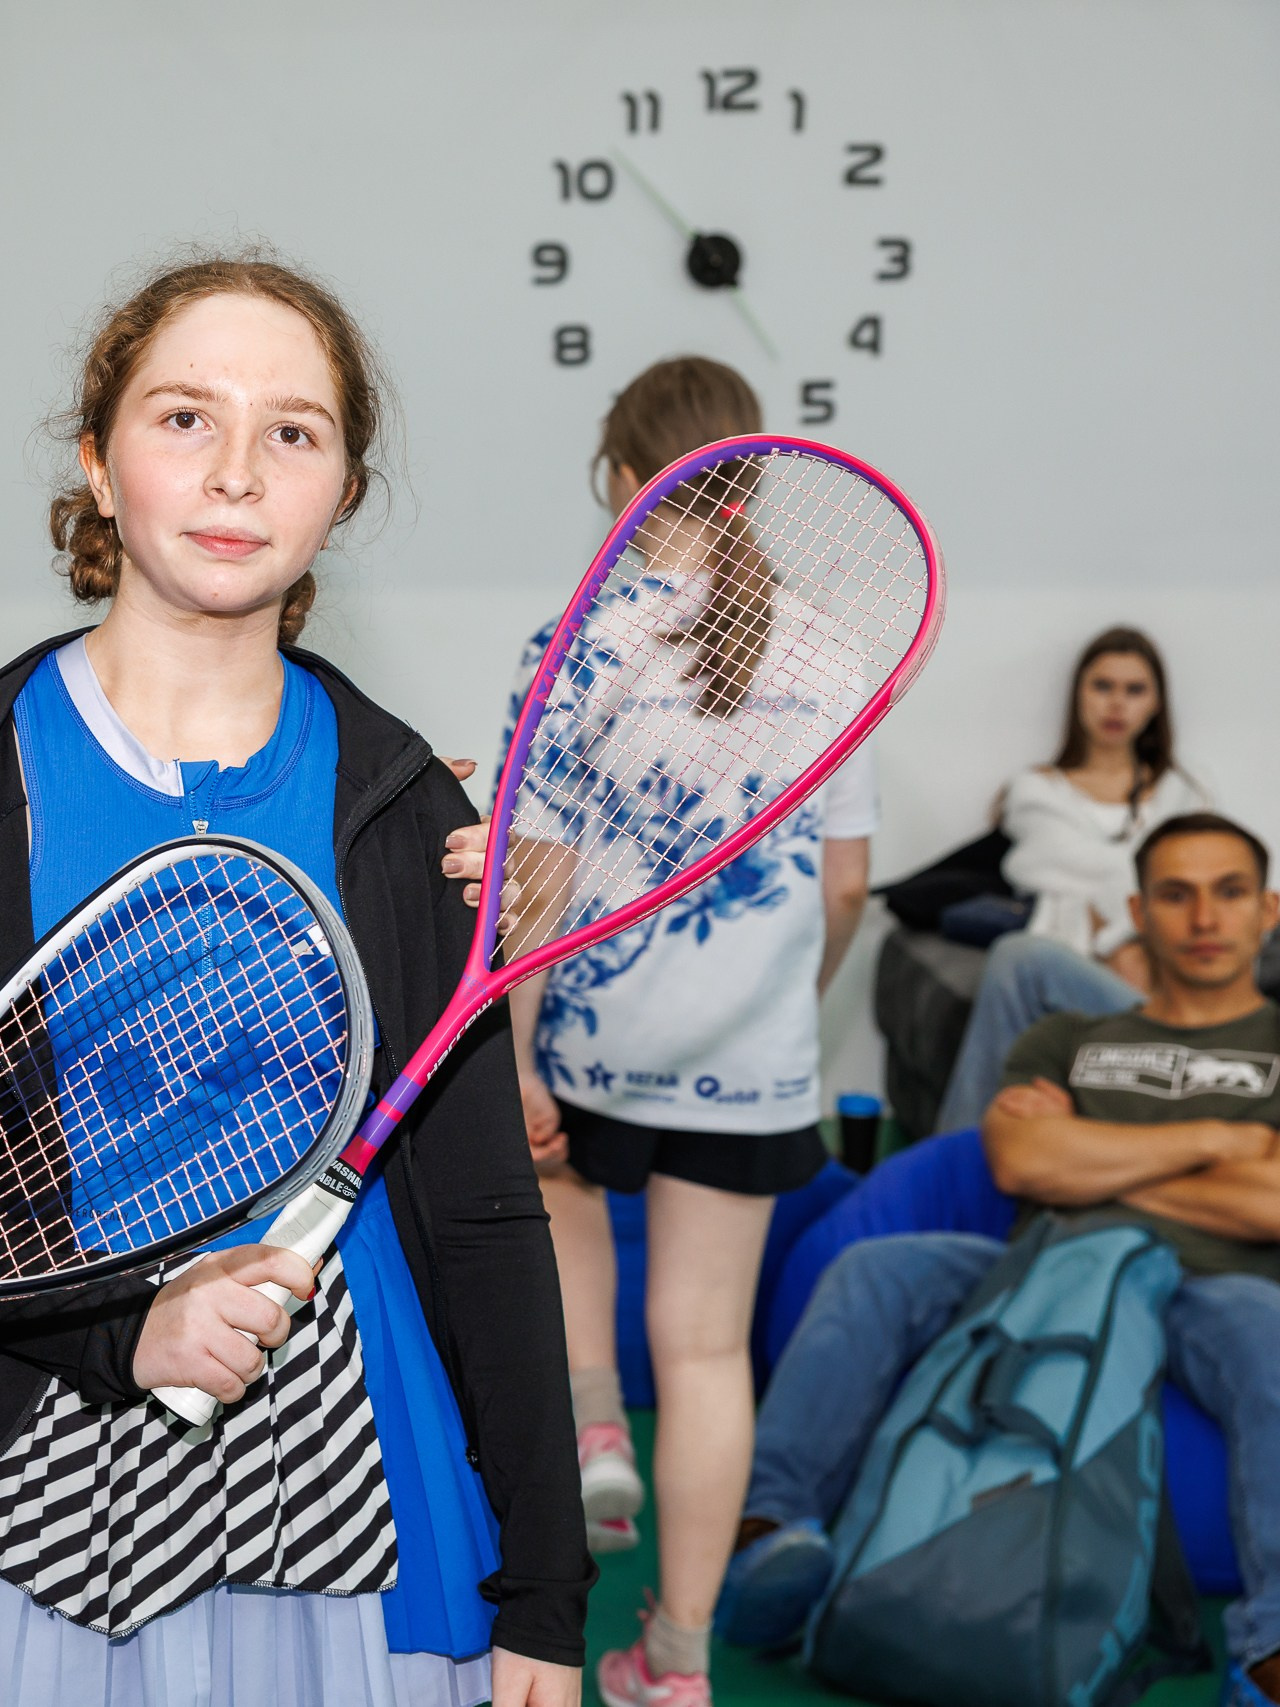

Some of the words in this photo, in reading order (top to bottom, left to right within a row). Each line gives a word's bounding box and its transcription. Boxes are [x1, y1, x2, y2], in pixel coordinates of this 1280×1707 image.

[621, 90, 661, 135] 11
[700, 67, 760, 113] 12
[788, 87, 806, 134] 1
[553, 158, 615, 203] 10
[842, 143, 885, 187] 2
[531, 241, 570, 286] 9
[875, 237, 912, 283] 3
[553, 323, 592, 368] 8
[847, 313, 883, 358] 4
[799, 379, 836, 426] 5
[426, 997, 493, 1082] Harrow
